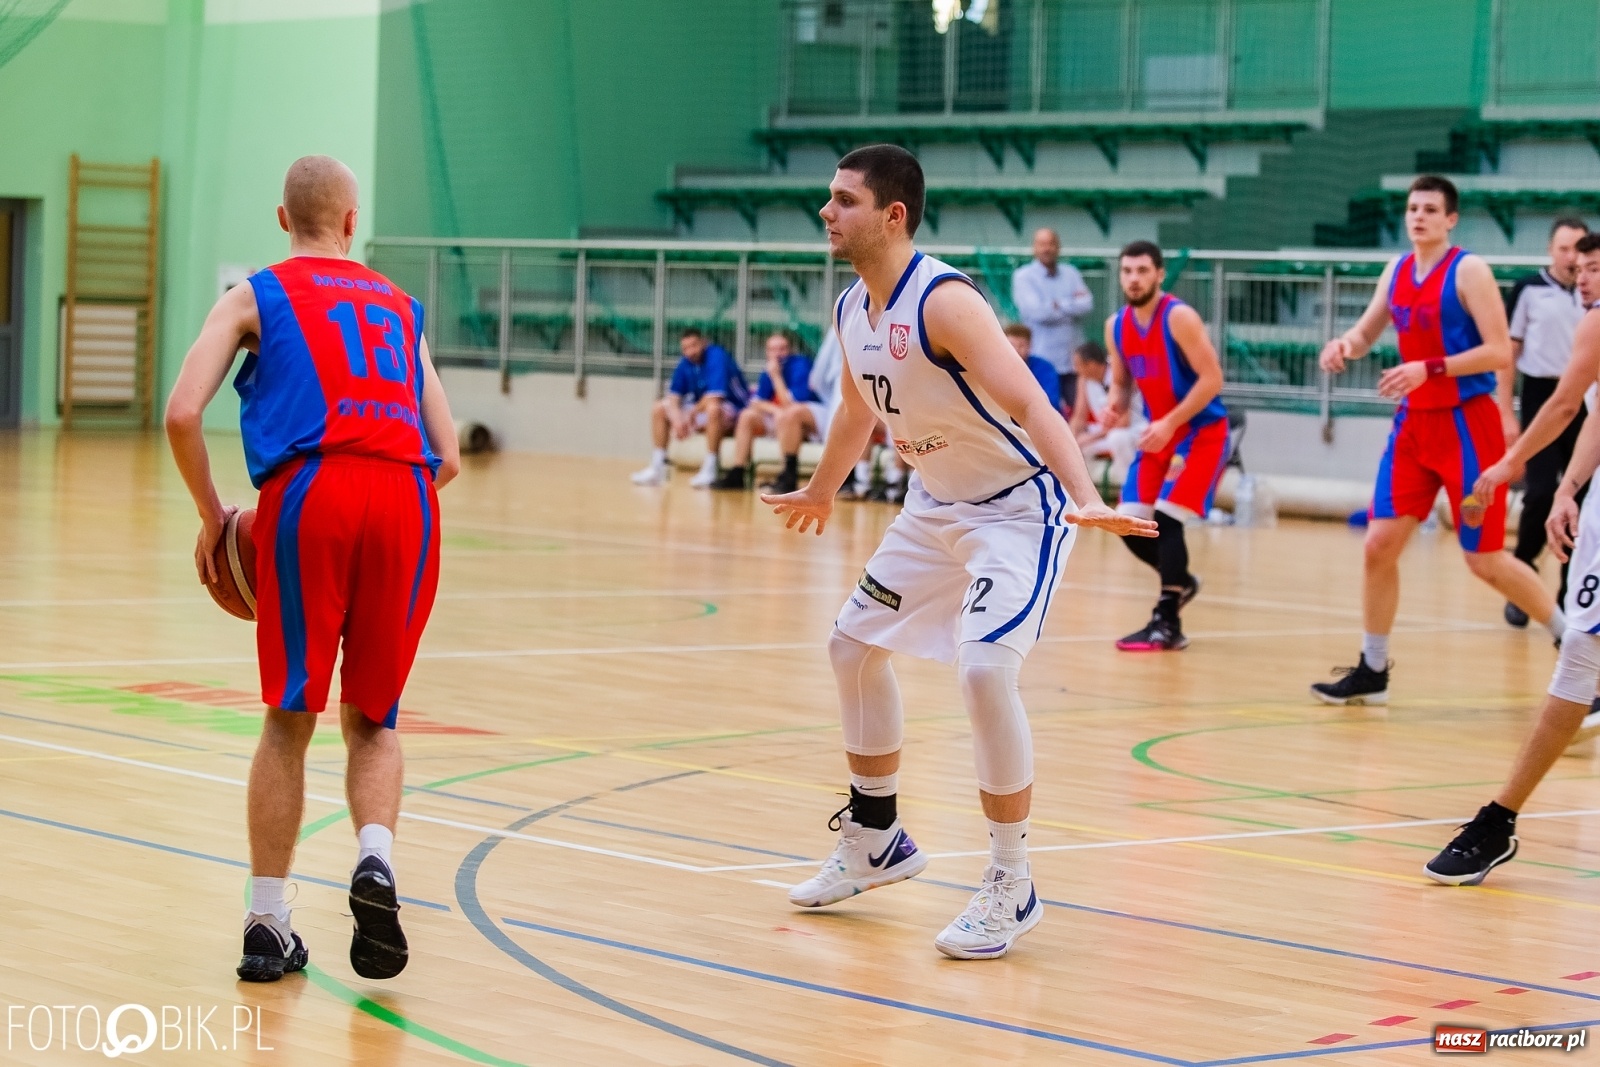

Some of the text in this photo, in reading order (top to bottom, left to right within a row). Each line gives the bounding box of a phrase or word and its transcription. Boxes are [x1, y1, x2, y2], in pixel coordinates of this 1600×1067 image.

[312, 274, 393, 296] MOSM
[327, 301, 409, 386] 13
[862, 373, 900, 415] 72
[338, 398, 418, 429] BYTOM
[1577, 574, 1600, 609] 8
